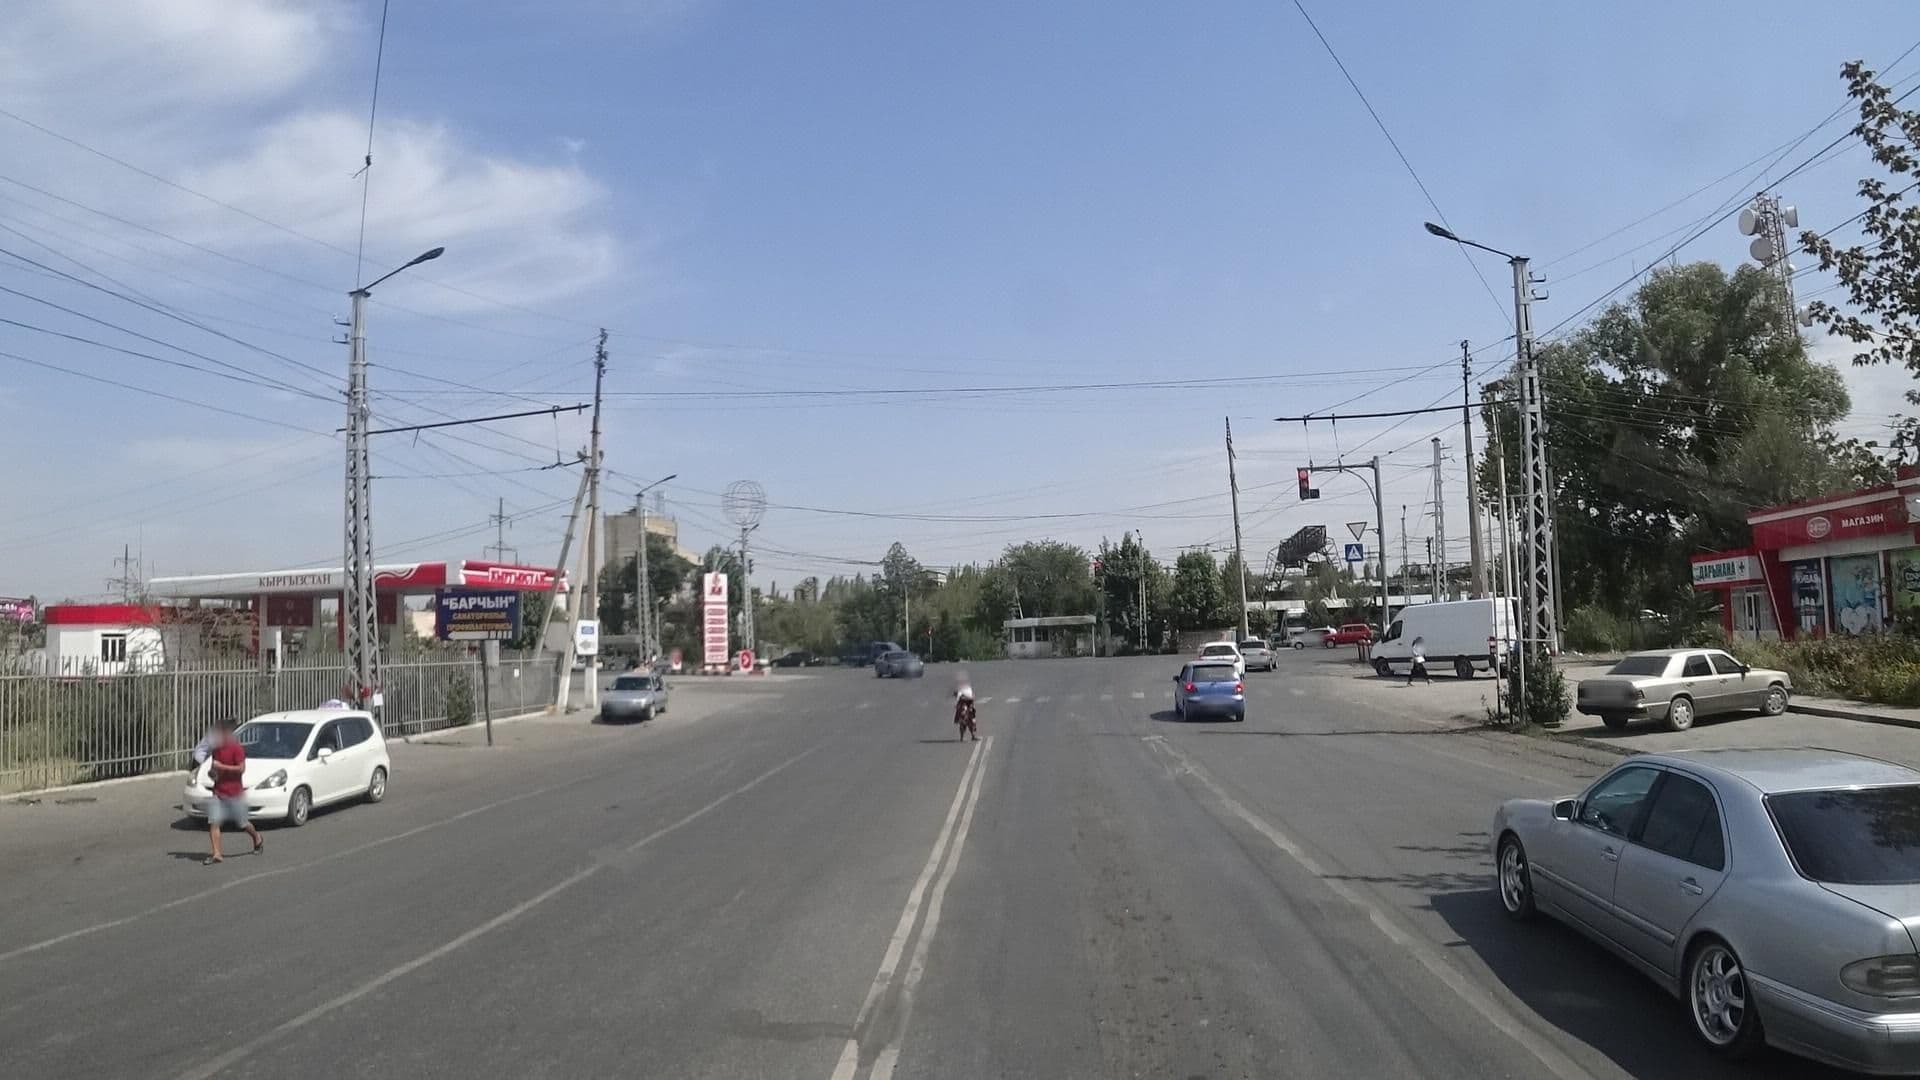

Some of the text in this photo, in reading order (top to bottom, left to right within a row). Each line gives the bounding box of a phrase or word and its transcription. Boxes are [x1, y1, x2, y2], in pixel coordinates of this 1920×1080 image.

[1841, 513, 1884, 528] МАГАЗИН
[259, 573, 332, 587] КЫРГЫЗСТАН
[442, 595, 515, 610] “БАРЧЫН”
